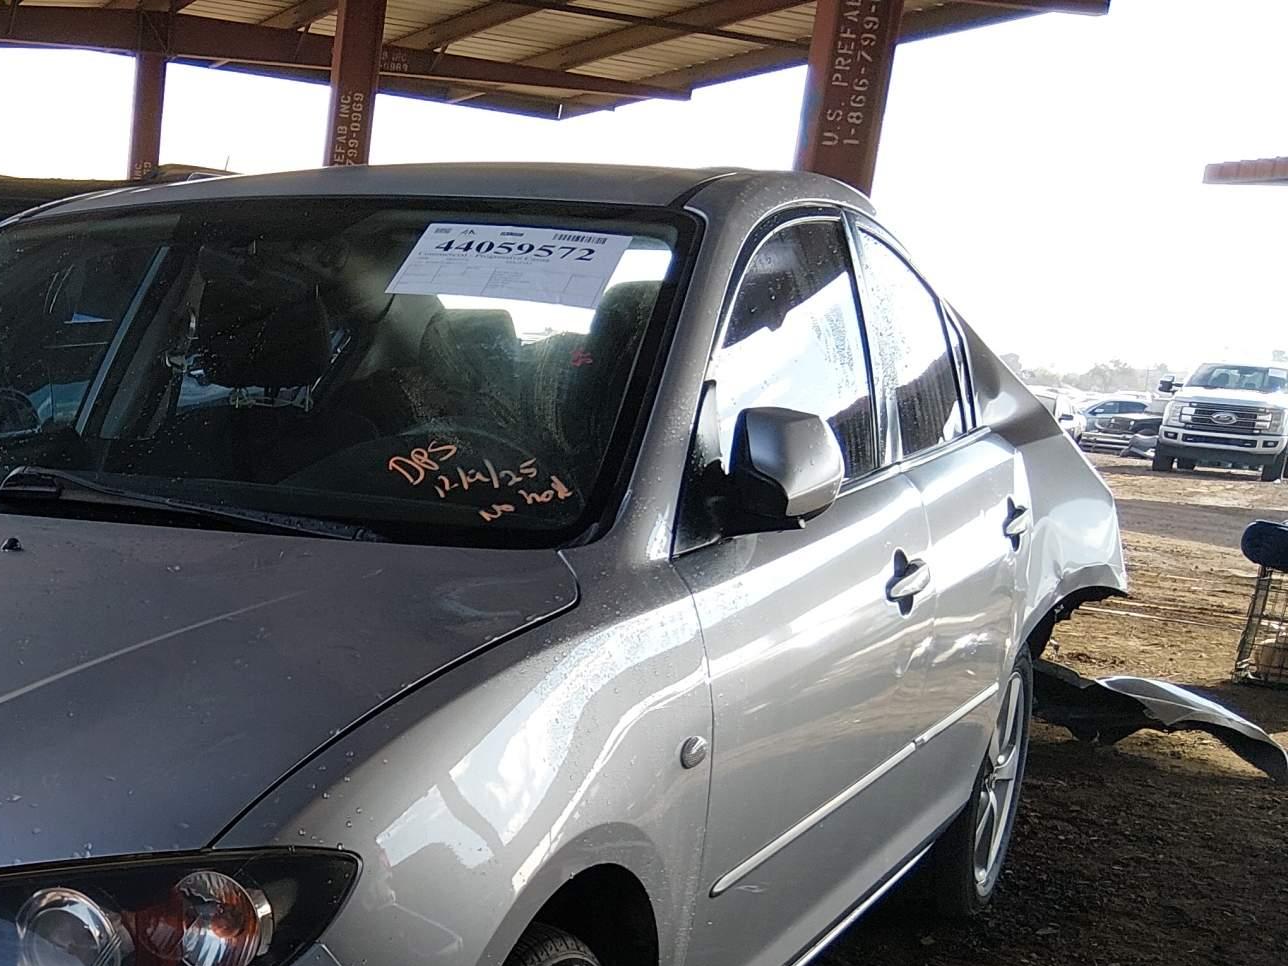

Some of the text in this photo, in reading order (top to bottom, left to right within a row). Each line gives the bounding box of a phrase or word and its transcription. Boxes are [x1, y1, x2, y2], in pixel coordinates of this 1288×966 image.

[843, 0, 880, 146] 1-866-799-
[822, 101, 845, 146] U.S.
[334, 126, 347, 166] EFAB
[435, 239, 597, 261] 44059572
